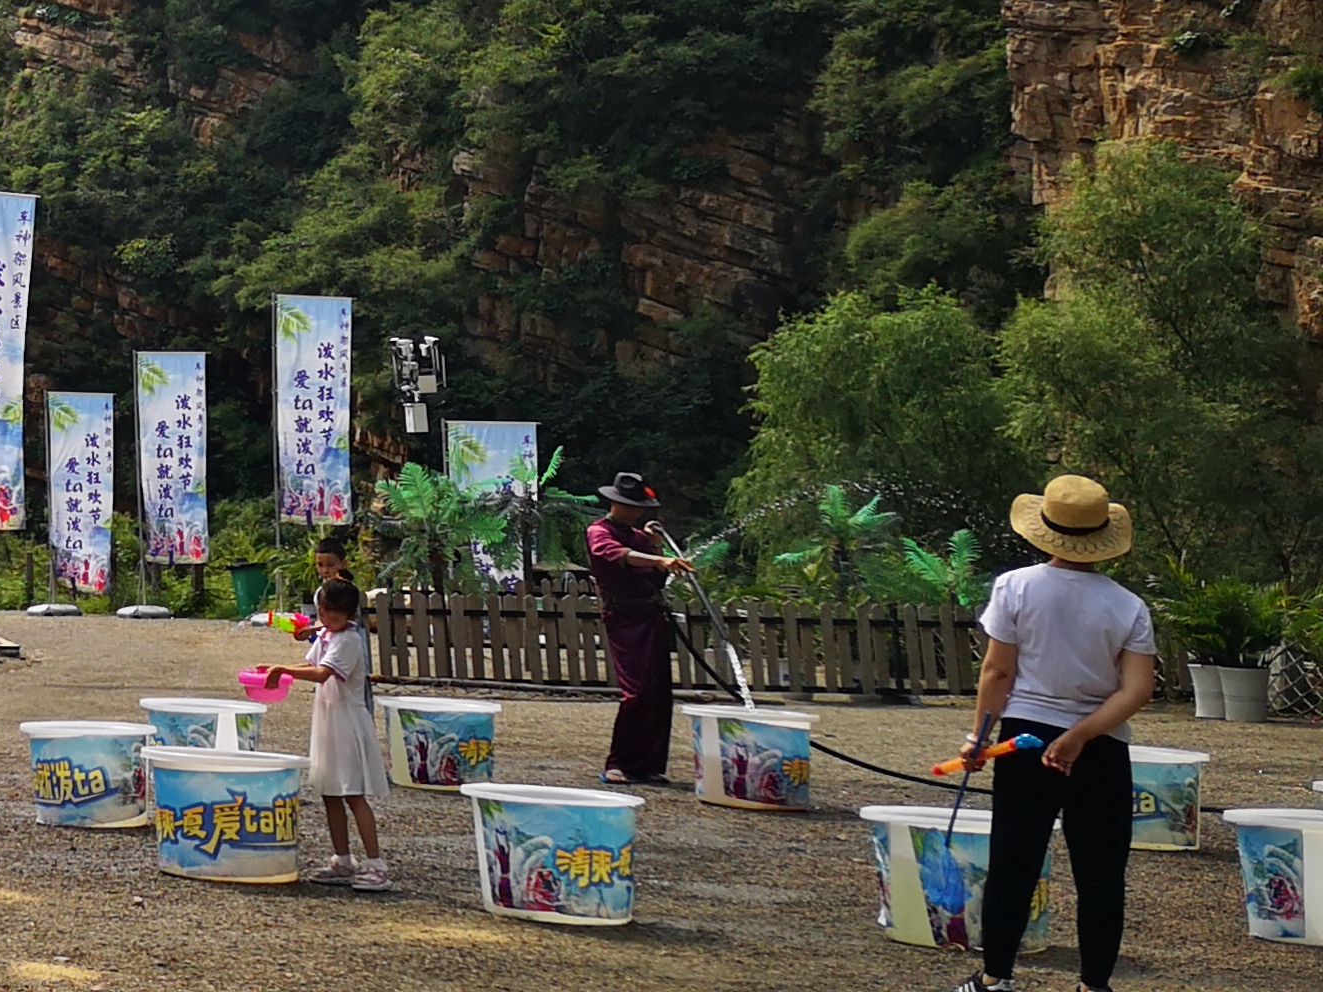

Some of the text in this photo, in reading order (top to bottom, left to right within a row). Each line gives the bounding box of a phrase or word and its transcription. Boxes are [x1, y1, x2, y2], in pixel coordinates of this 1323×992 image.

[10, 209, 32, 331] 车神架风景区
[175, 394, 193, 491] 泼水狂欢节
[293, 369, 316, 476] 爱ta就泼ta
[316, 341, 336, 446] 泼水狂欢节
[65, 457, 84, 551] 爱ta就泼ta
[85, 433, 103, 525] 泼水狂欢节
[155, 420, 174, 519] 爱ta就泼ta
[33, 760, 106, 800] 就泼ta
